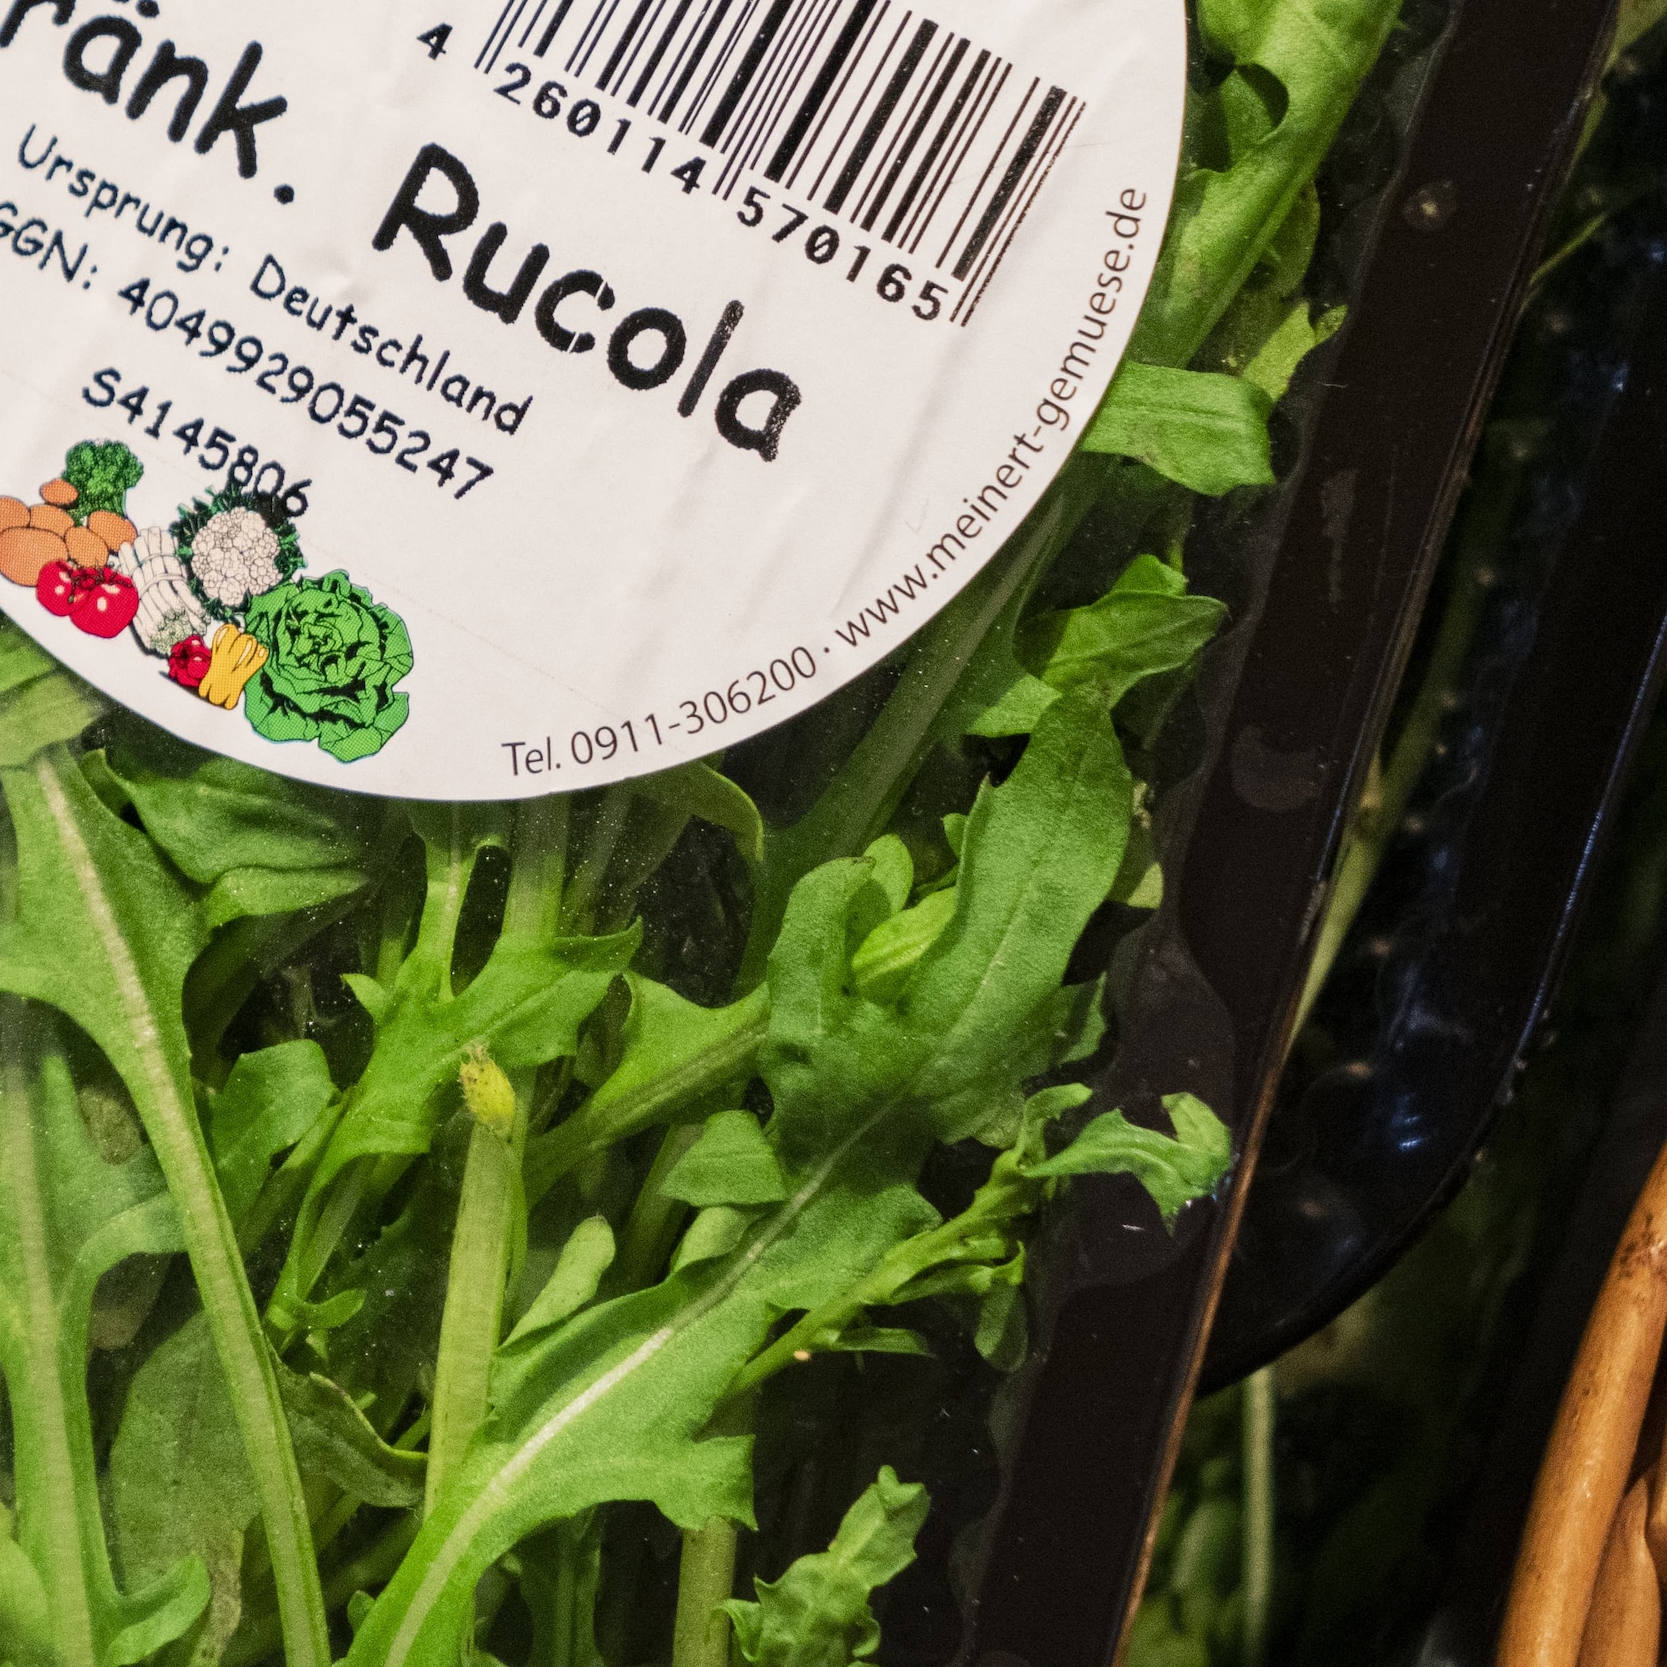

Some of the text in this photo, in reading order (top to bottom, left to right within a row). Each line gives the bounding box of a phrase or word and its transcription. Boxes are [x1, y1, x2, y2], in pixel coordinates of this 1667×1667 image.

[17, 123, 533, 435] Ursprung: Deutschland
[372, 143, 802, 463] Rucola
[415, 23, 948, 324] 4 260114 570165
[82, 367, 312, 518] S4145806
[118, 277, 494, 500] 4049929055247
[501, 186, 1148, 778] Tel. 0911-306200 www.meinert-gemuese.de
